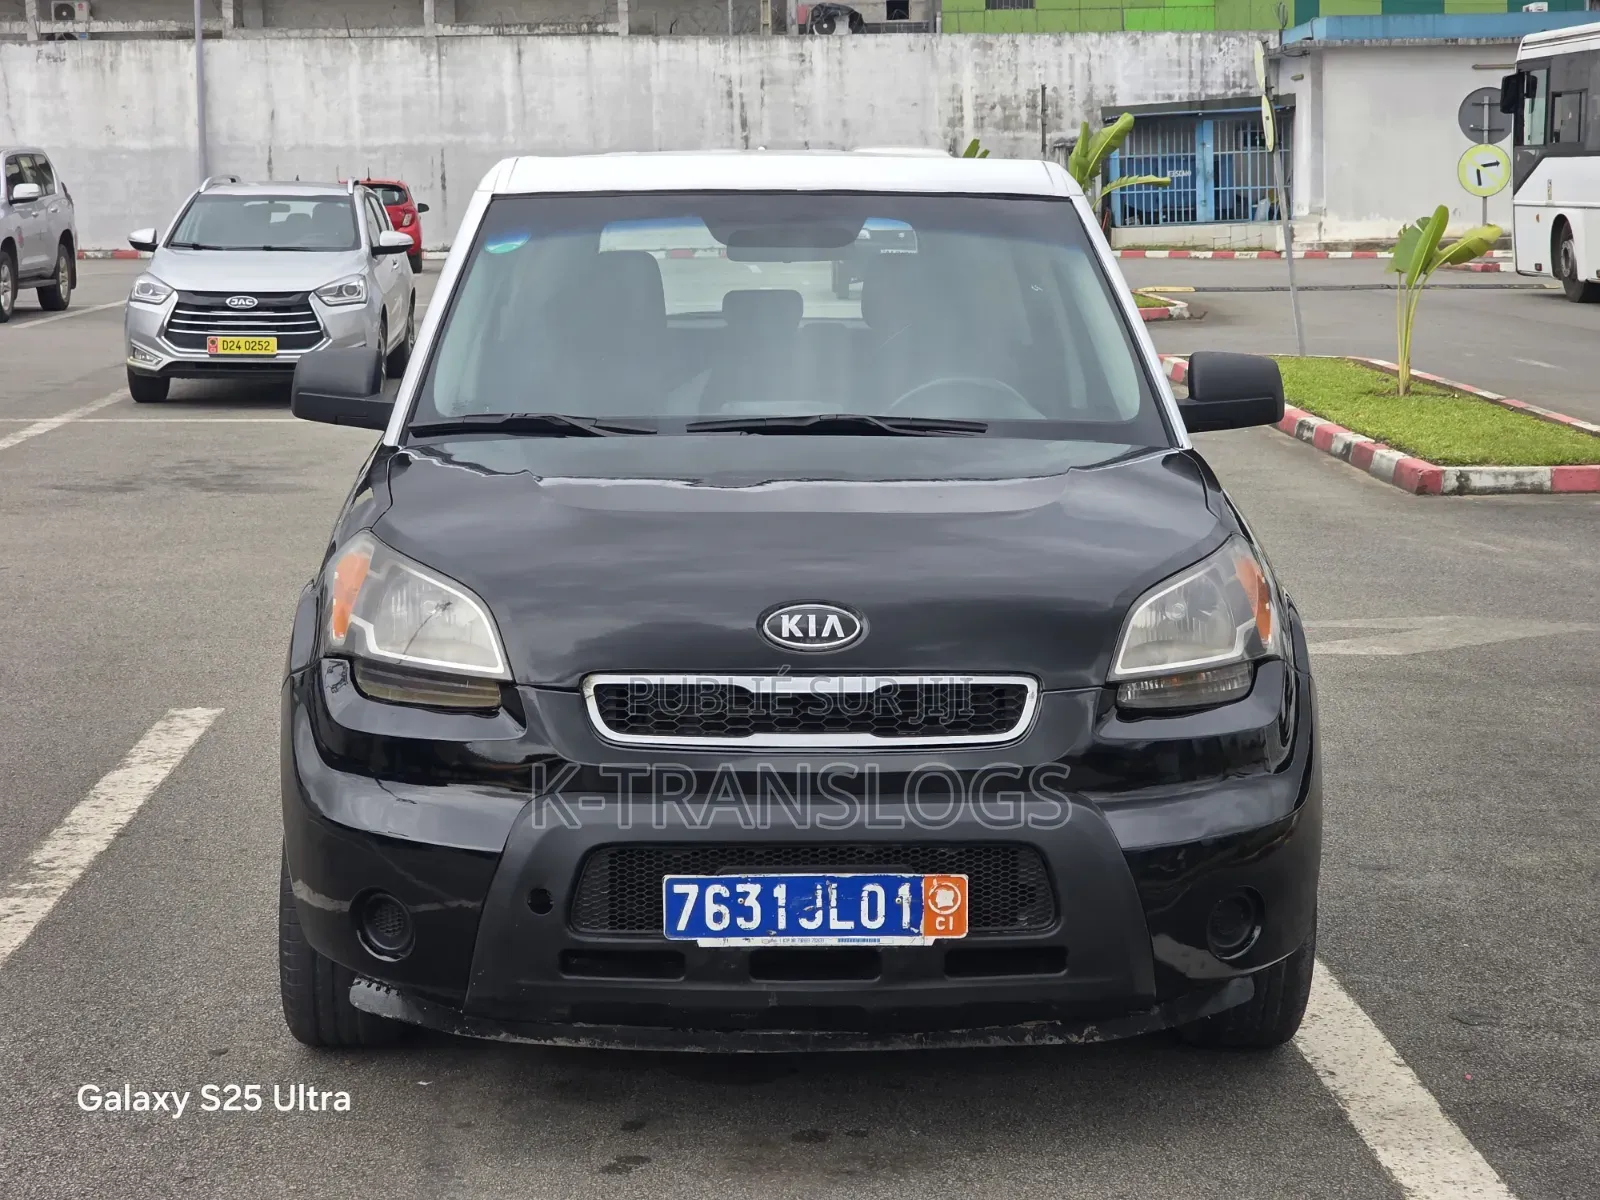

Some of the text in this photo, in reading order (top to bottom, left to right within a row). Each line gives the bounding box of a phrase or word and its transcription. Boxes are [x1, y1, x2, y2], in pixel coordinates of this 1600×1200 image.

[230, 298, 254, 306] JAC
[222, 340, 242, 351] D24
[244, 340, 271, 351] 0252
[780, 614, 845, 638] KIA
